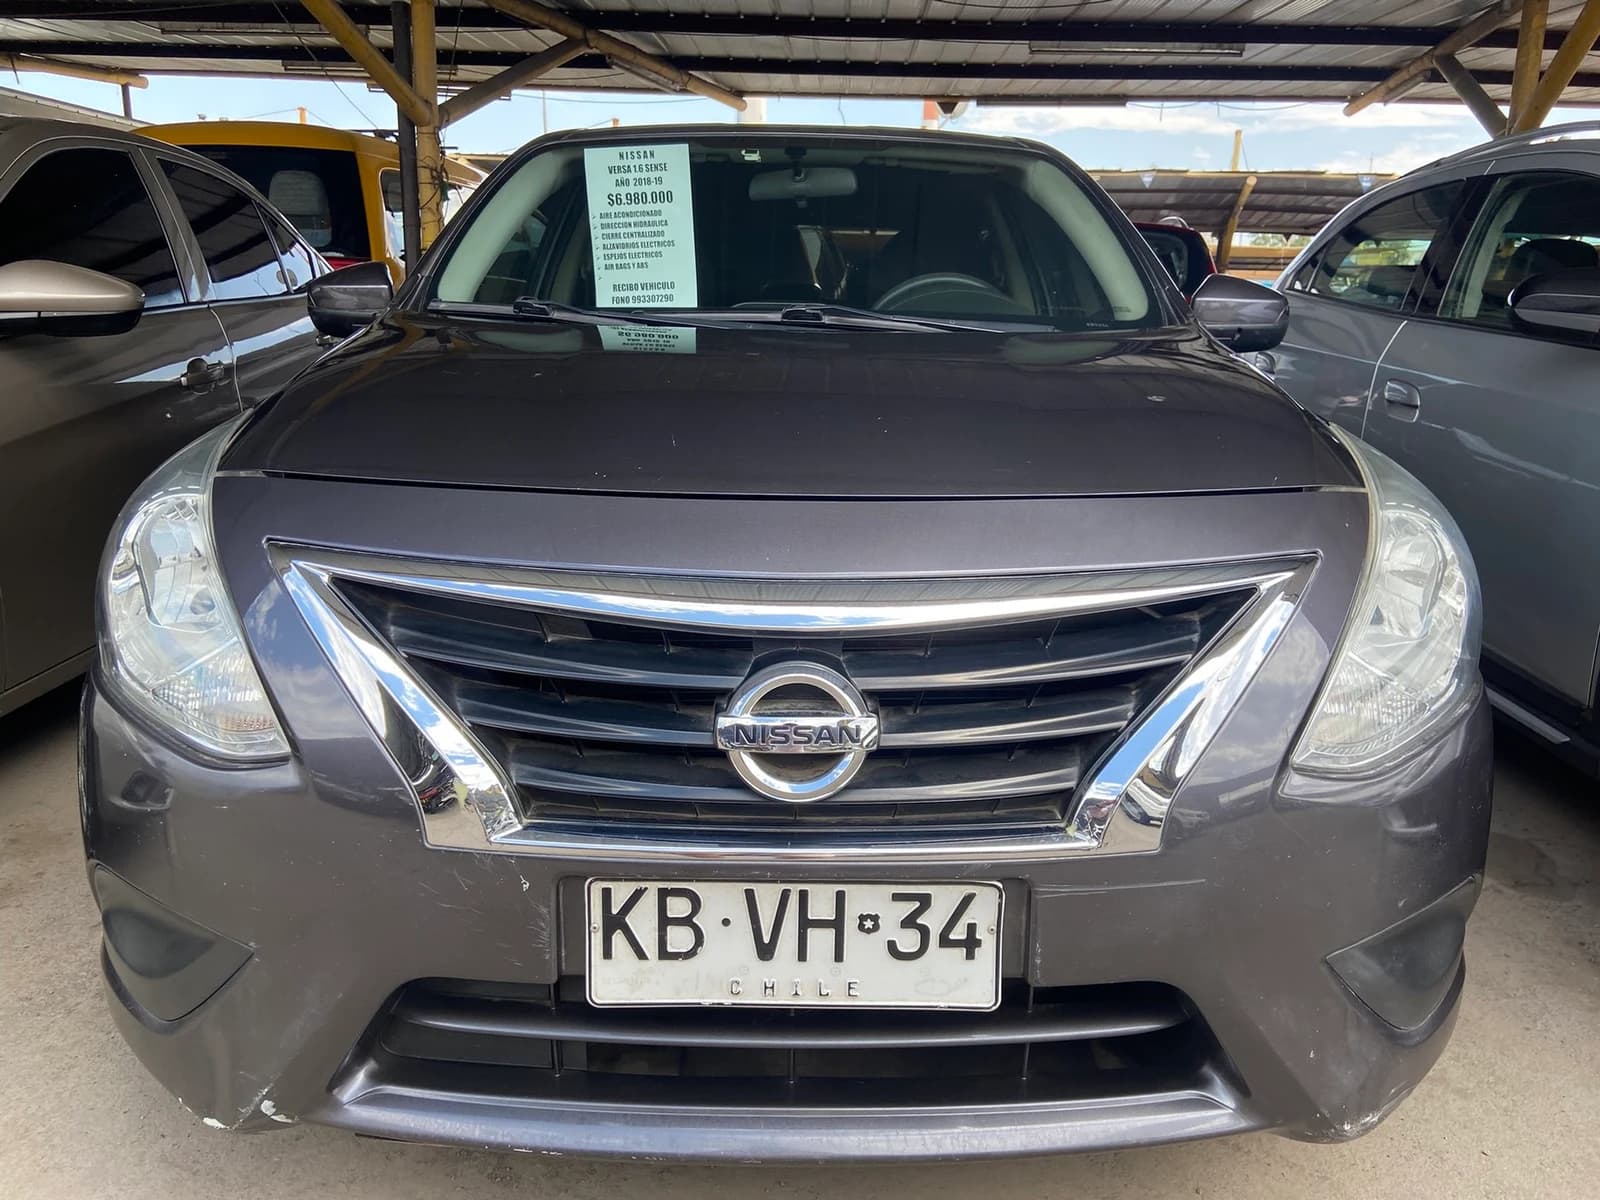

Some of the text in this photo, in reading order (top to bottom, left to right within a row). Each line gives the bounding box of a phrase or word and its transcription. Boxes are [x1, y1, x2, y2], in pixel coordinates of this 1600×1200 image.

[619, 150, 655, 160] NISSAN
[608, 163, 668, 174] VERSA 1.6 SENSE
[615, 176, 663, 187] AÑO 2018-19
[607, 190, 673, 207] $6.980.000
[600, 209, 662, 219] AIRE ACONDICIONADO
[600, 220, 668, 230] DIRECCION HIDRAULICA
[601, 230, 665, 240] CIERRE CENTRALIZADO
[603, 240, 675, 250] ALZAVIDRIOS ELECTRICOS
[603, 251, 663, 261] ESPEJOS ELECTRICOS
[615, 262, 631, 270] BAGS
[637, 261, 648, 269] ABS
[612, 281, 675, 292] RECIBO VEHICULO
[612, 294, 674, 304] FONO 993307290
[734, 724, 862, 746] NISSAN
[729, 979, 860, 998] CHILE
